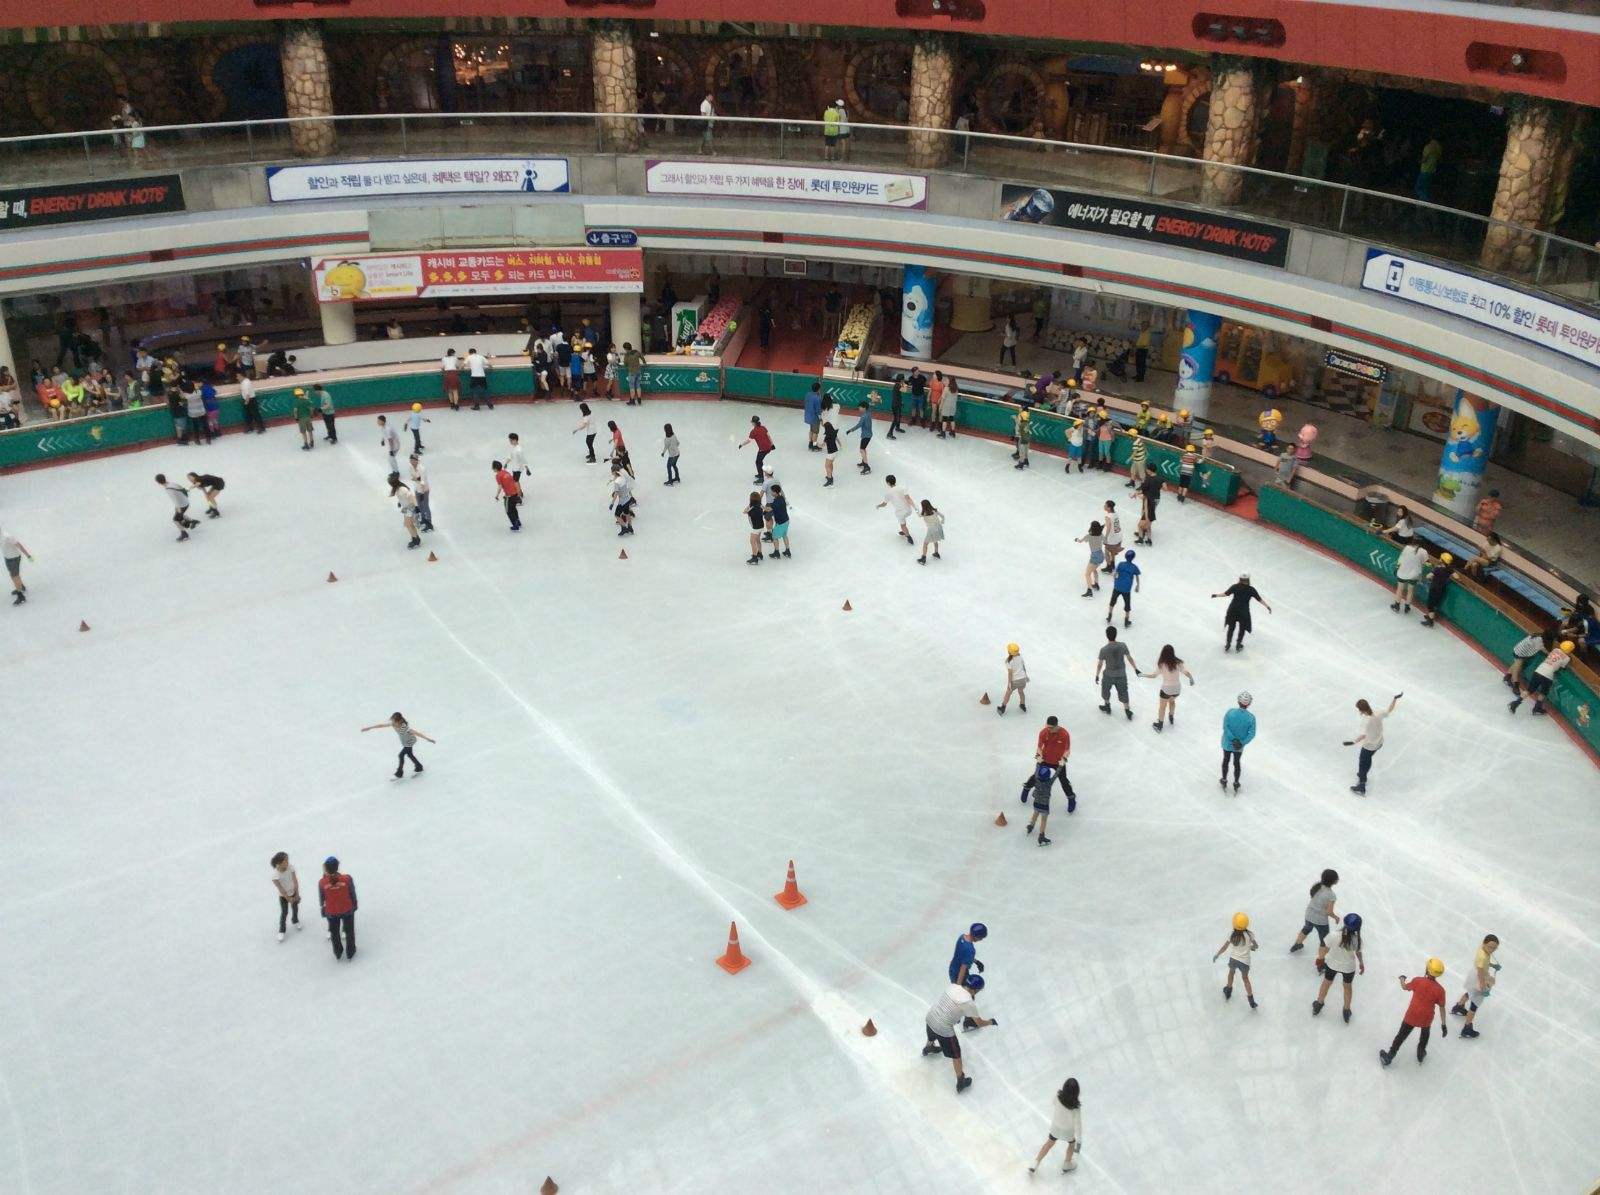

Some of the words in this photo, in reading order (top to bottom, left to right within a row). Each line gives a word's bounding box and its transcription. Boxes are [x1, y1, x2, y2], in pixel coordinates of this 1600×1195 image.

[307, 176, 338, 190] 할인과
[340, 174, 362, 188] 적립
[432, 170, 462, 184] 혜택은
[463, 170, 490, 184] 택일?
[492, 170, 519, 183] 왜죠?
[662, 173, 684, 184] 그래서
[685, 174, 708, 186] 할인과
[725, 175, 734, 188] 두
[751, 176, 775, 189] 혜택을
[776, 177, 786, 190] 한
[810, 178, 830, 192] 롯데
[832, 180, 879, 196] 투인원카드
[30, 196, 85, 215] ENERGY
[87, 189, 127, 210] DRINK
[1067, 203, 1108, 223] 에너지가
[1109, 209, 1142, 229] 필요할
[1156, 217, 1203, 239] ENERGY
[1203, 224, 1239, 245] DRINK
[600, 232, 620, 244] 출구
[427, 256, 456, 270] 캐시비
[458, 256, 505, 268] 교통카드는
[471, 270, 491, 281] 모두
[508, 270, 525, 280] 되는
[528, 269, 545, 280] 카드
[547, 269, 576, 280] 입니다.
[1469, 296, 1487, 311] 최고
[1489, 300, 1512, 321] 10%
[1512, 307, 1537, 330] 할인
[1535, 315, 1559, 336] 롯데
